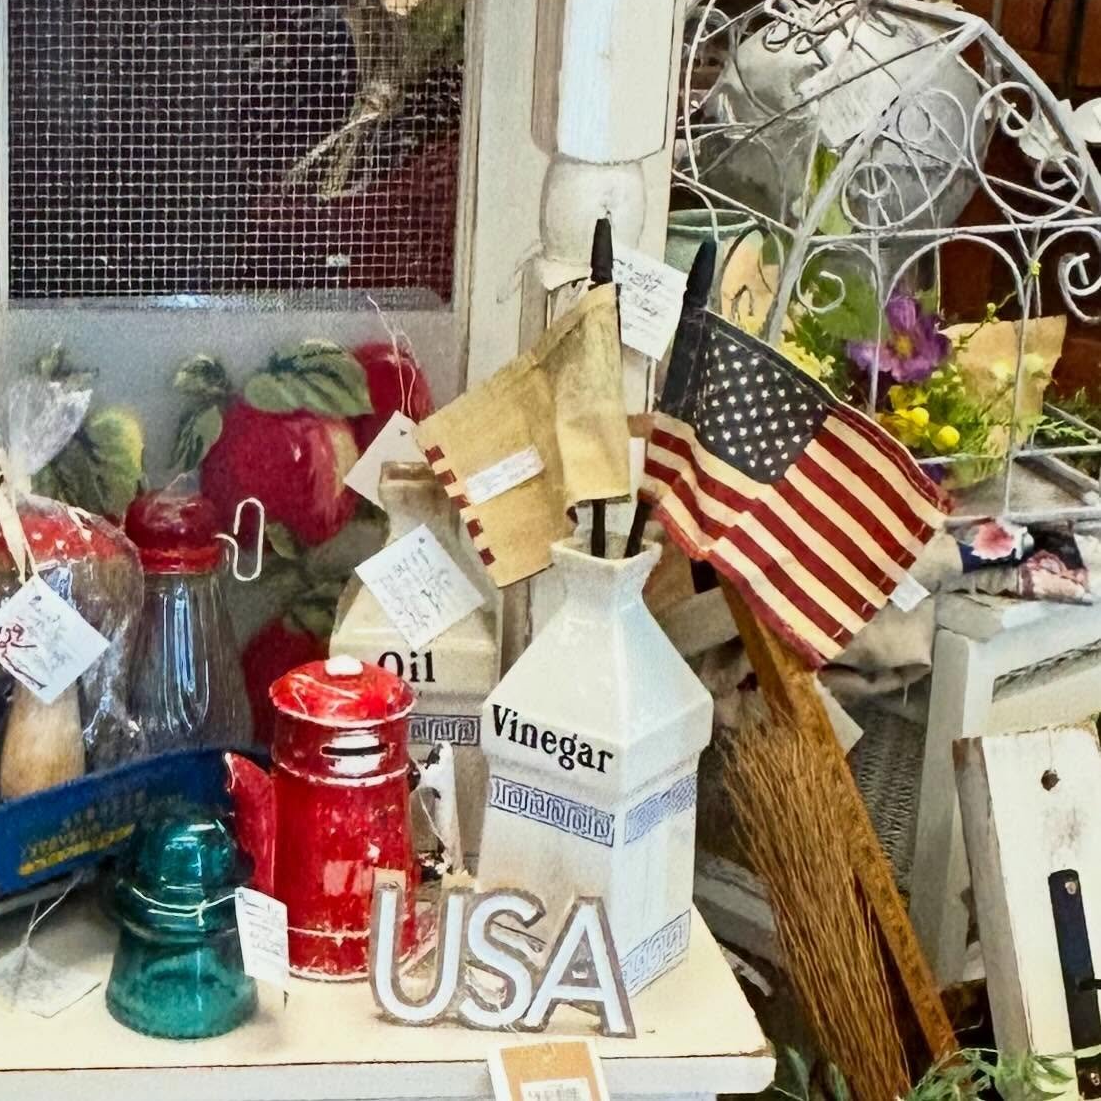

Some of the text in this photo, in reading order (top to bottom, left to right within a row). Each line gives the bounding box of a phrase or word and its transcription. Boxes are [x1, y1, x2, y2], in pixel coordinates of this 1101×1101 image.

[377, 650, 436, 684] Oil
[492, 703, 614, 775] Vinegar
[369, 869, 637, 1039] USA
